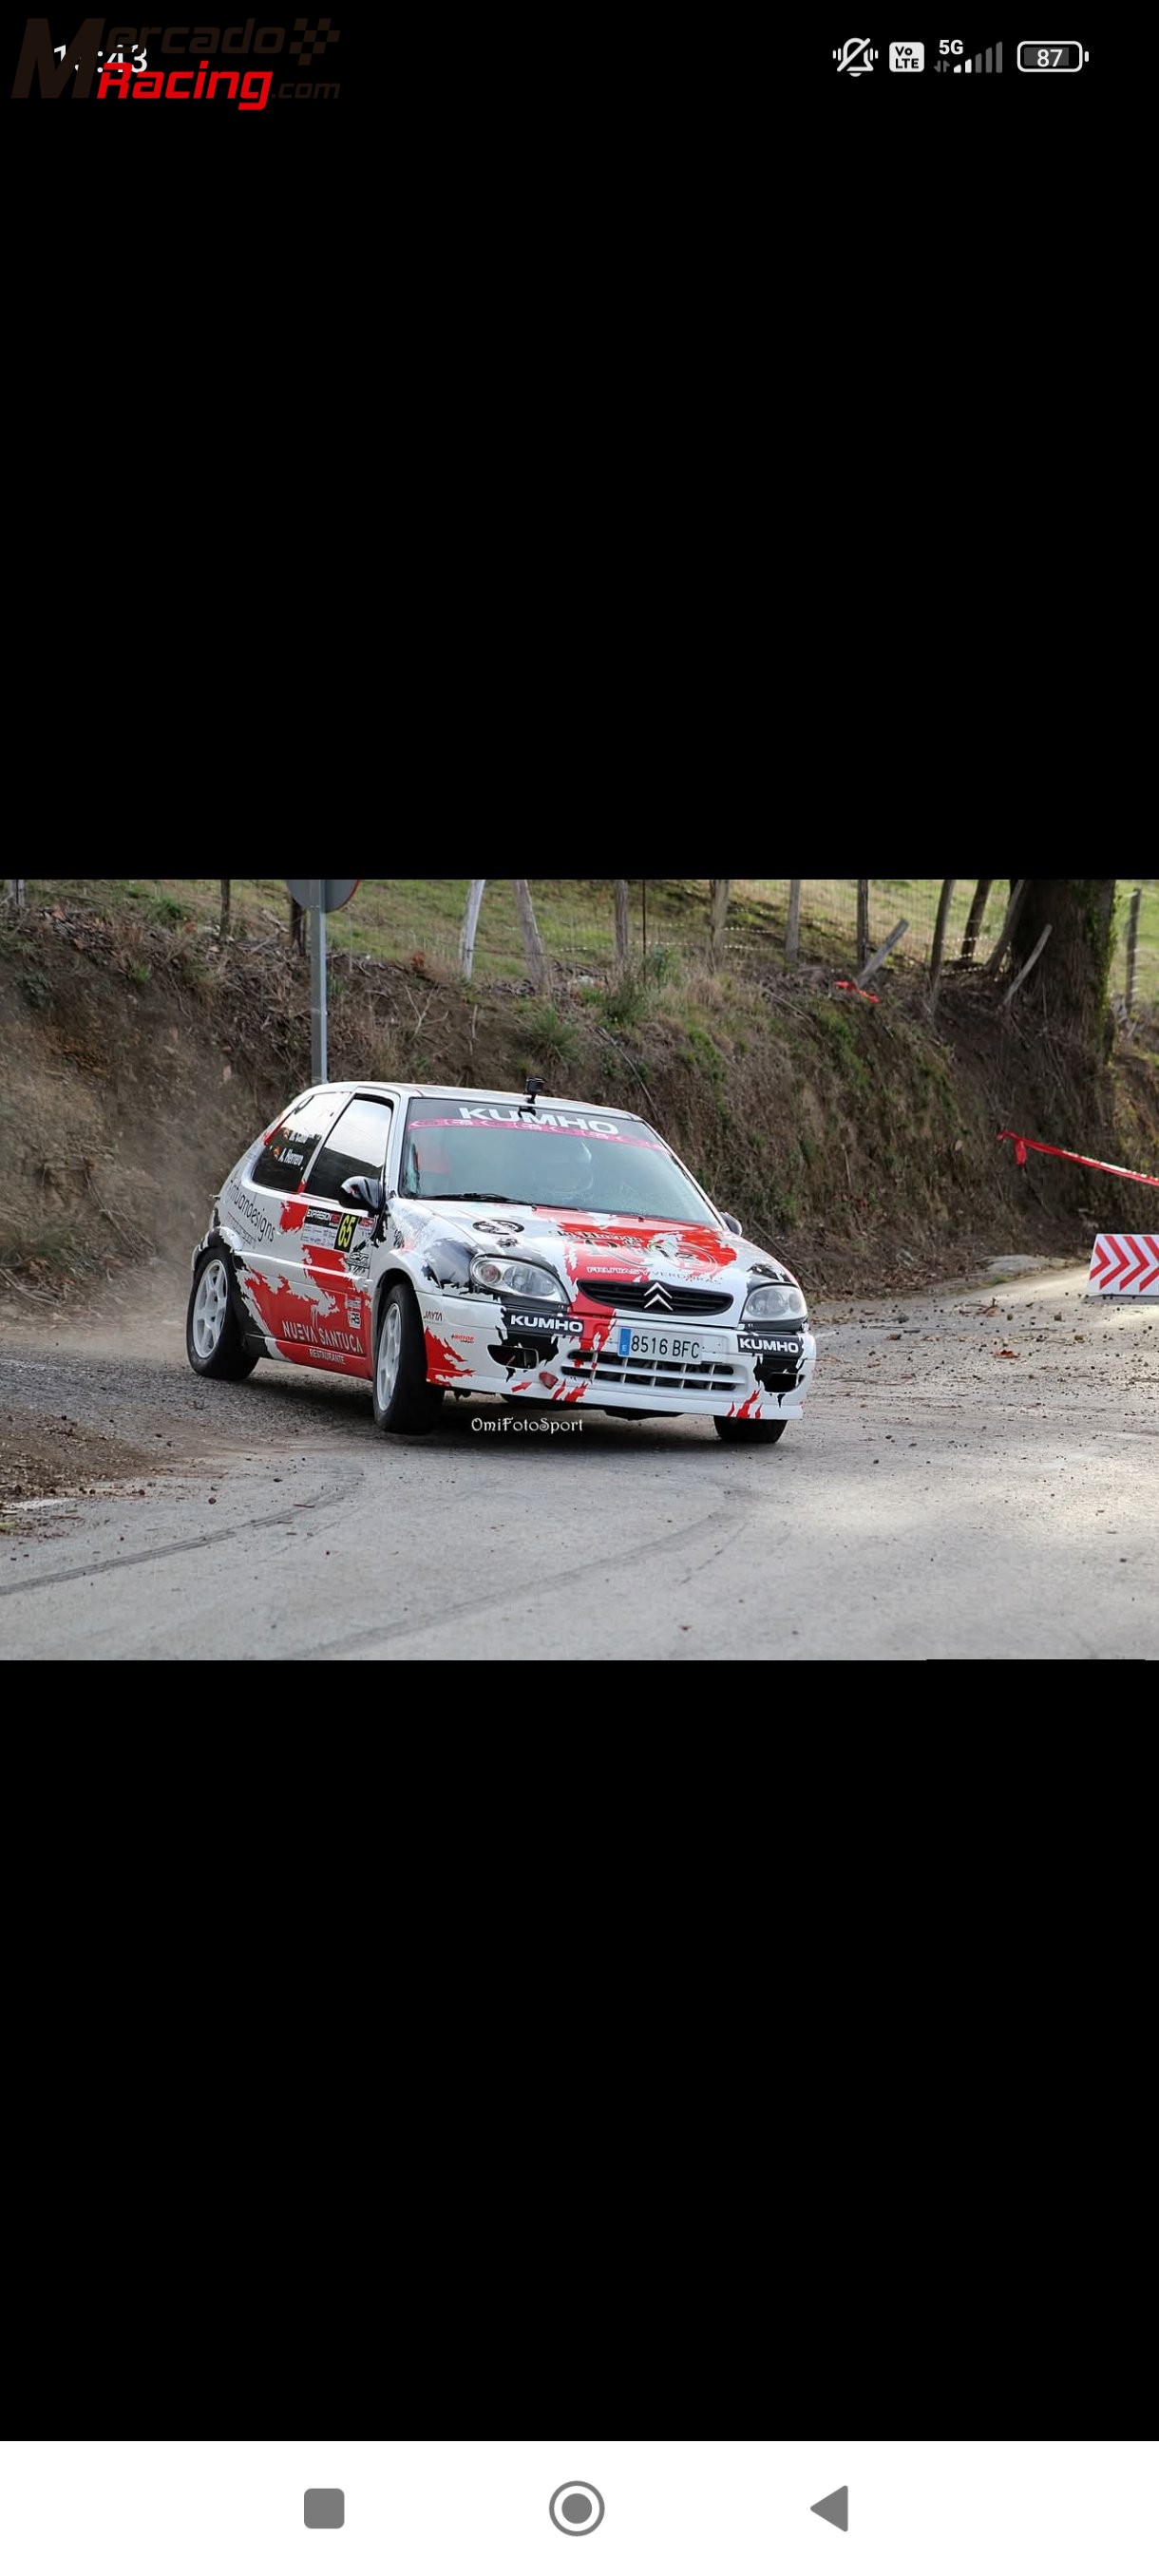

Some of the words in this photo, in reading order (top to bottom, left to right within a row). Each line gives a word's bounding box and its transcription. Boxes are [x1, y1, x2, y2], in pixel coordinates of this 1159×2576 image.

[895, 46, 913, 56] Vo
[939, 40, 964, 55] 5G
[53, 45, 148, 73] 1:43
[895, 58, 920, 69] LTE
[1036, 48, 1064, 67] 87
[458, 1107, 620, 1135] KUMHO
[337, 1214, 356, 1249] 65
[510, 1314, 584, 1333] KUMHO
[281, 1319, 318, 1344] NUEVA
[318, 1327, 365, 1354] SANTUCA
[738, 1337, 800, 1354] KUMHO
[309, 1348, 346, 1365] RESTAURANTE
[631, 1335, 669, 1355] 8516
[672, 1339, 700, 1359] BFC
